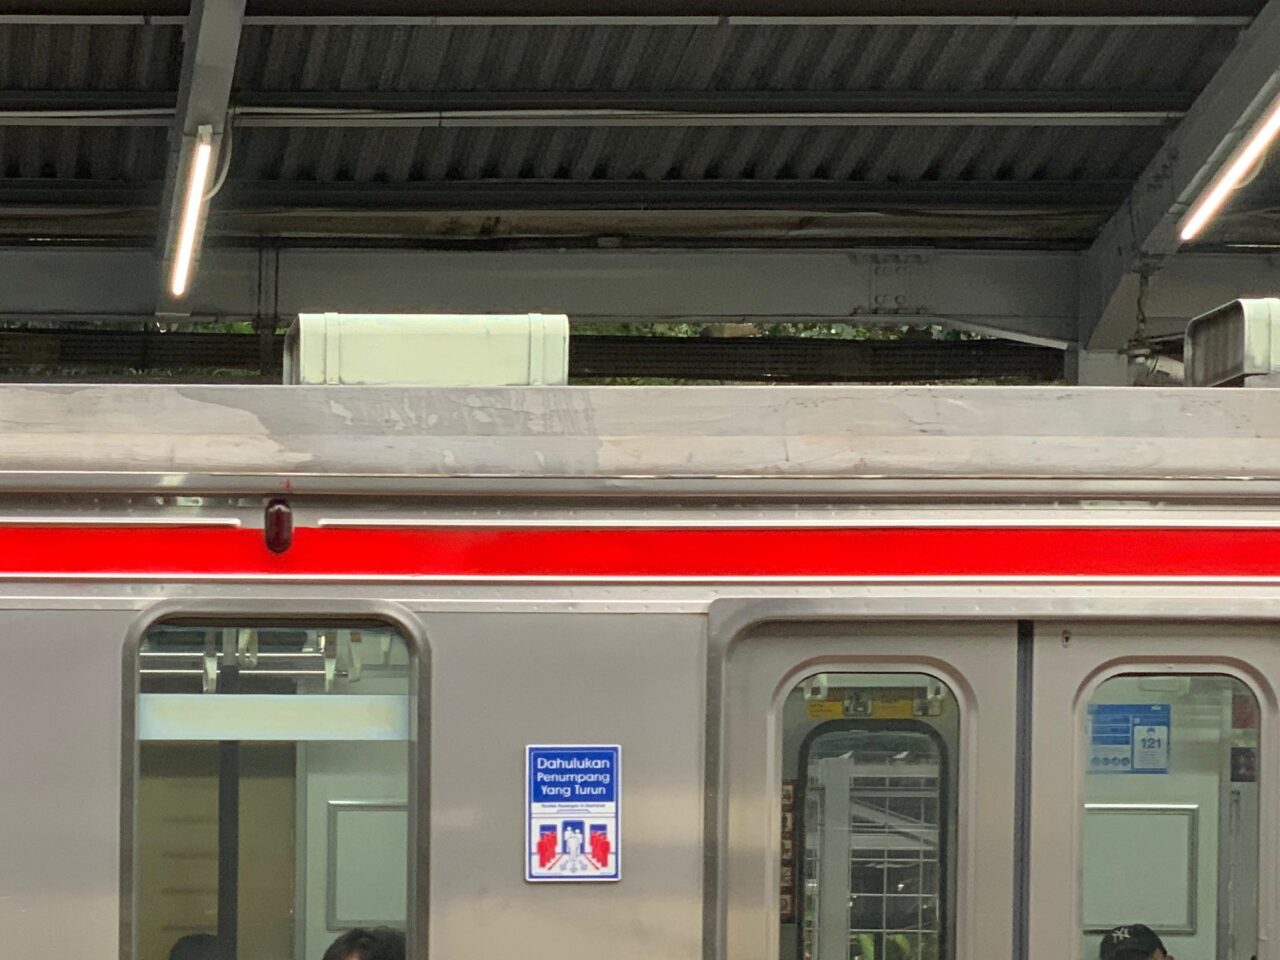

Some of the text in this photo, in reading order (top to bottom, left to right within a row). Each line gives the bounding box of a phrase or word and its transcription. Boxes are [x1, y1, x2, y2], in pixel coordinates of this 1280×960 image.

[1140, 738, 1162, 749] 121
[536, 757, 610, 769] Dahulukan
[536, 771, 610, 784] Penumpang
[540, 784, 606, 797] Yang Turun
